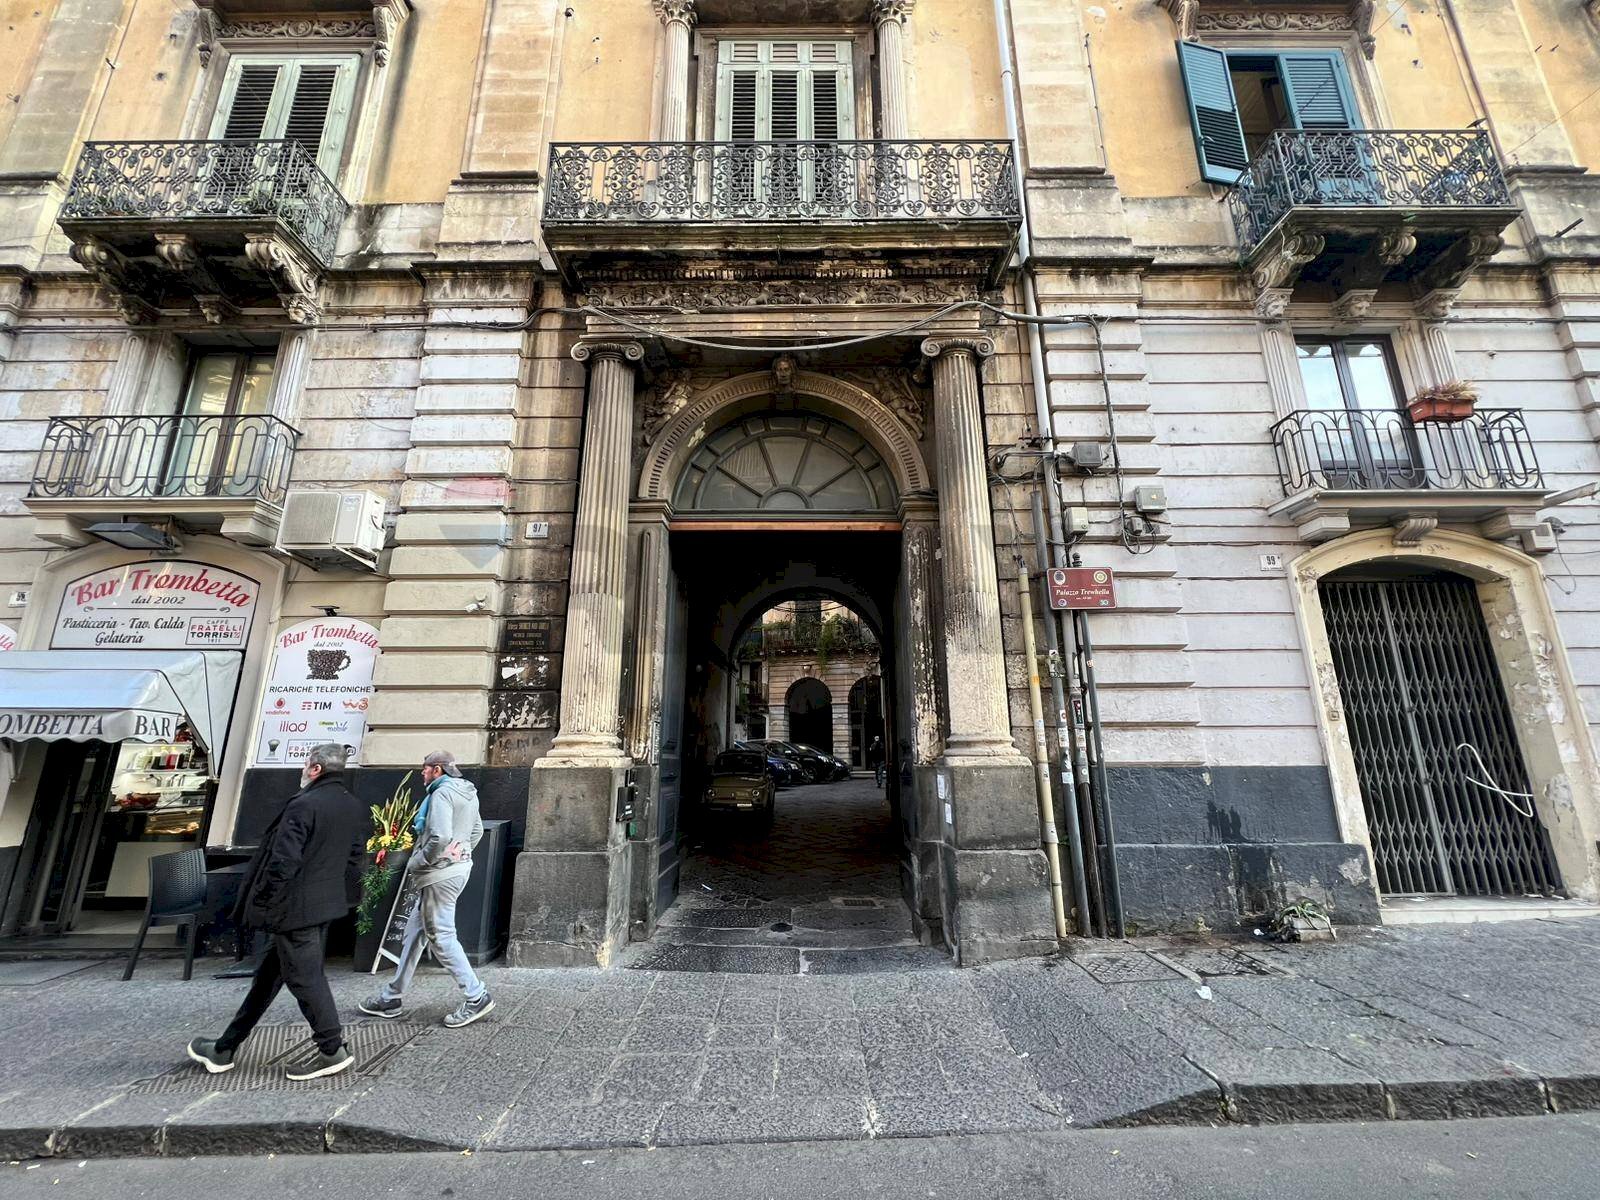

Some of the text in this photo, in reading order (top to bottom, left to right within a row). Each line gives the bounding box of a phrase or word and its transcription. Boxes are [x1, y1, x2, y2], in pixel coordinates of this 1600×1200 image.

[71, 568, 251, 608] Bar Trombetta
[1055, 588, 1079, 596] Palazzo
[131, 595, 186, 605] dal 2002
[62, 616, 117, 630] Pasticceria
[128, 618, 151, 630] Tav.
[153, 616, 185, 630] Calda
[95, 631, 145, 646] Gelateria
[280, 624, 379, 649] Bar Trombetta
[313, 701, 332, 710] TIM
[0, 714, 103, 735] OMBETTA
[134, 715, 172, 737] BAR
[279, 721, 308, 733] iliad
